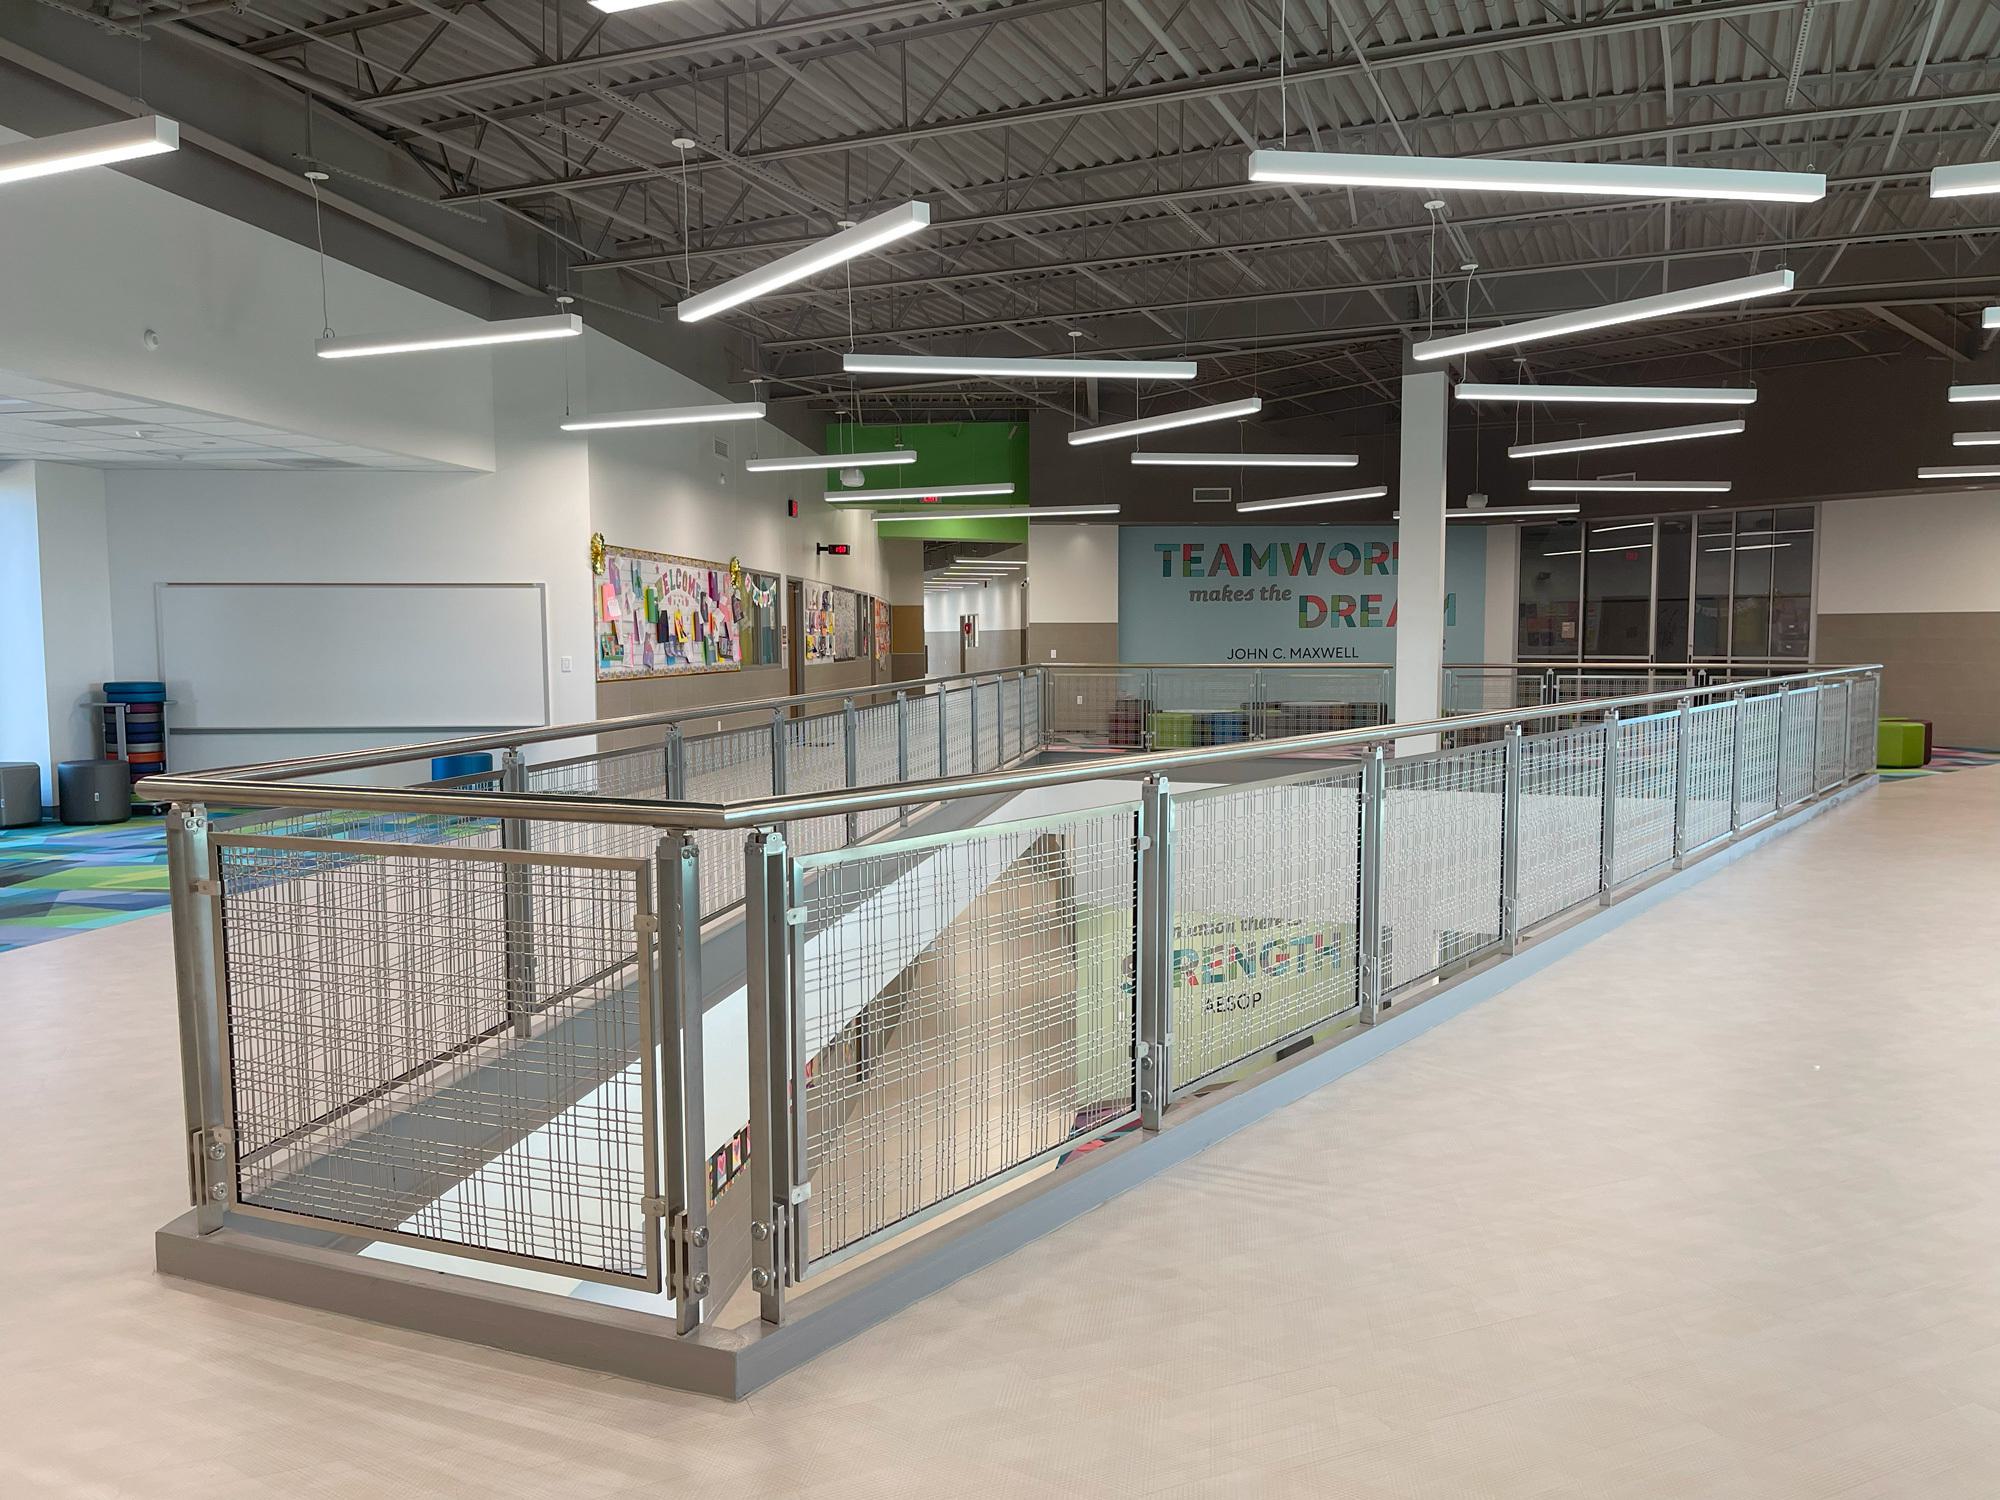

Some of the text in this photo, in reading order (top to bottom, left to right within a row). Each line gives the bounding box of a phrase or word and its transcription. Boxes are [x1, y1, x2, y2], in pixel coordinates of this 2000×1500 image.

[1189, 583, 1292, 602] makes the
[1227, 646, 1359, 660] JOHN C. MAXWELL
[1203, 992, 1262, 1014] AESOP
